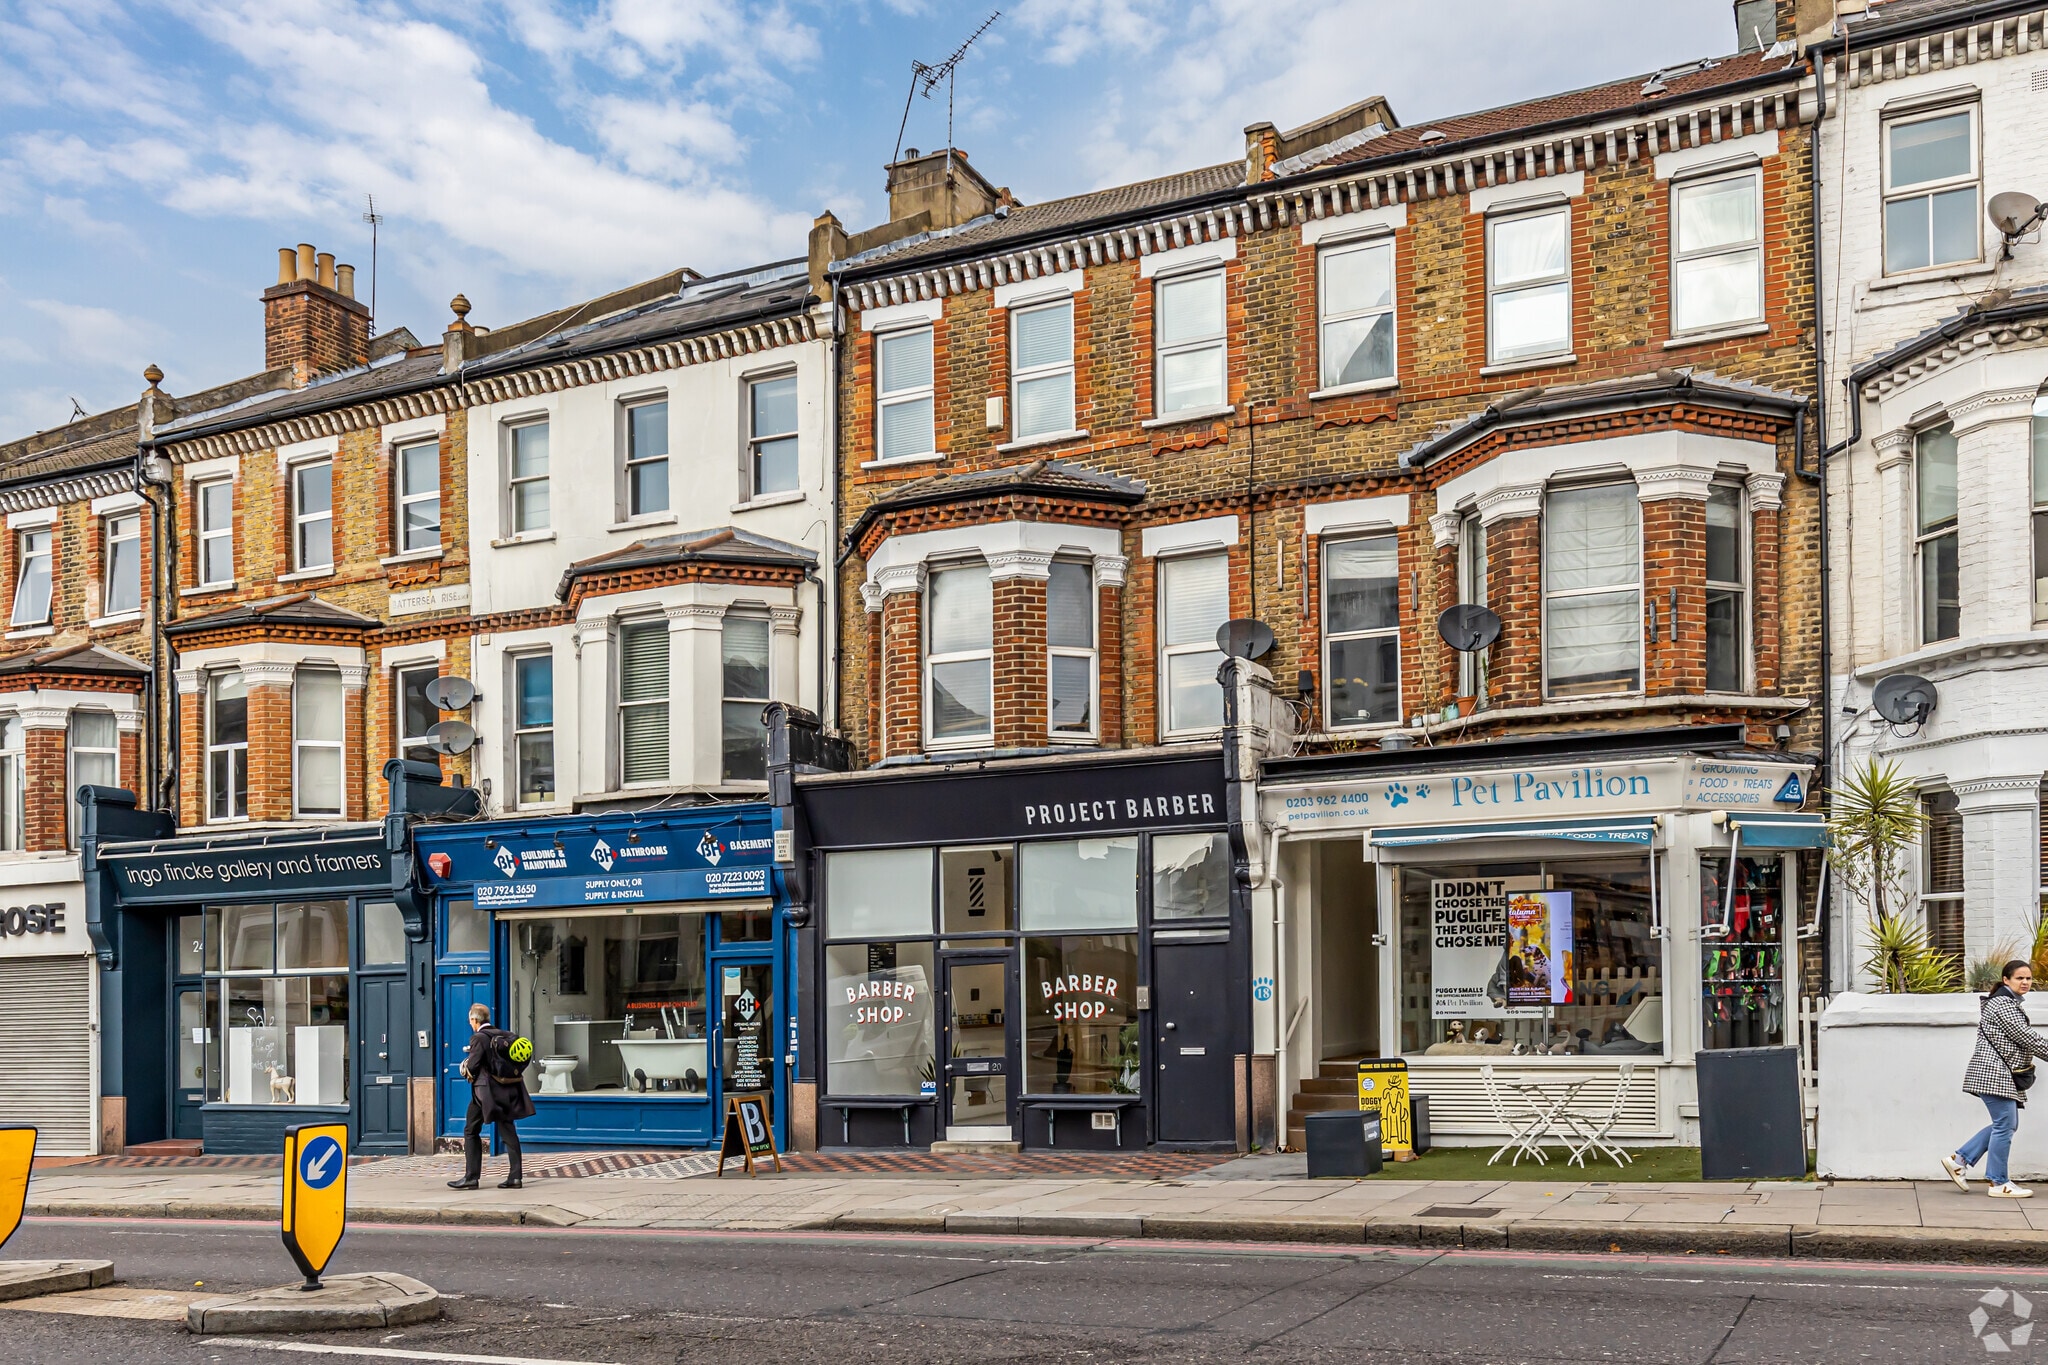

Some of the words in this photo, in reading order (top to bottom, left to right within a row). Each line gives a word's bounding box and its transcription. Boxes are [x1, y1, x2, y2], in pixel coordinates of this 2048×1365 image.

[441, 592, 458, 602] RISE
[1702, 764, 1758, 774] GROOMING
[1451, 777, 1501, 806] Pet
[1512, 768, 1650, 802] Pavilion
[1699, 778, 1729, 788] FOOD
[1743, 779, 1773, 789] TREATS
[1286, 797, 1313, 808] 0203
[1316, 795, 1337, 805] 962
[1341, 792, 1369, 803] 4400
[1696, 792, 1760, 803] ACCESSORIES
[1025, 800, 1116, 824] PROJECT
[1126, 793, 1214, 818] BARBER
[1288, 807, 1370, 821] petpavilion.co.uk
[1608, 832, 1648, 840] TREATS
[729, 839, 773, 851] BASEMENT
[521, 849, 556, 860] BUILDING
[558, 849, 565, 858] &
[620, 846, 668, 857] BATHROOMS
[124, 866, 162, 887] ingo
[164, 861, 214, 881] fincke
[218, 859, 272, 882] gallery
[277, 856, 312, 875] and
[314, 853, 382, 872] framers
[522, 859, 567, 870] HANDYMAN
[705, 873, 721, 882] 020
[722, 872, 742, 881] 7223
[743, 870, 765, 880] 0093
[585, 880, 610, 889] SUPPLY
[610, 879, 631, 887] ONLY,
[631, 878, 642, 886] OR
[1435, 883, 1440, 898] I
[1443, 881, 1505, 897] DIDN'T
[478, 887, 493, 896] 020
[494, 886, 514, 895] 7924
[516, 884, 537, 894] 3650
[585, 891, 609, 900] SUPPLY
[611, 891, 617, 899] &
[618, 890, 645, 898] INSTALL
[1435, 899, 1482, 908] CHOOSE
[1484, 898, 1506, 907] THE
[0, 902, 66, 939] OSE
[1435, 909, 1506, 923] PUGLIFE.
[1435, 925, 1457, 935] THE
[1460, 924, 1506, 934] PUGLIFE
[1435, 935, 1481, 948] CHOSE
[1485, 935, 1506, 946] ME
[459, 965, 468, 974] 22
[1041, 974, 1118, 999] BARBER
[846, 981, 916, 1005] BARBER
[1257, 988, 1270, 998] 18
[857, 1006, 904, 1024] SHOP
[1054, 1001, 1106, 1020] SHOP
[991, 1063, 1002, 1071] 20
[1360, 1097, 1382, 1105] DOGGY
[741, 1102, 765, 1144] B
